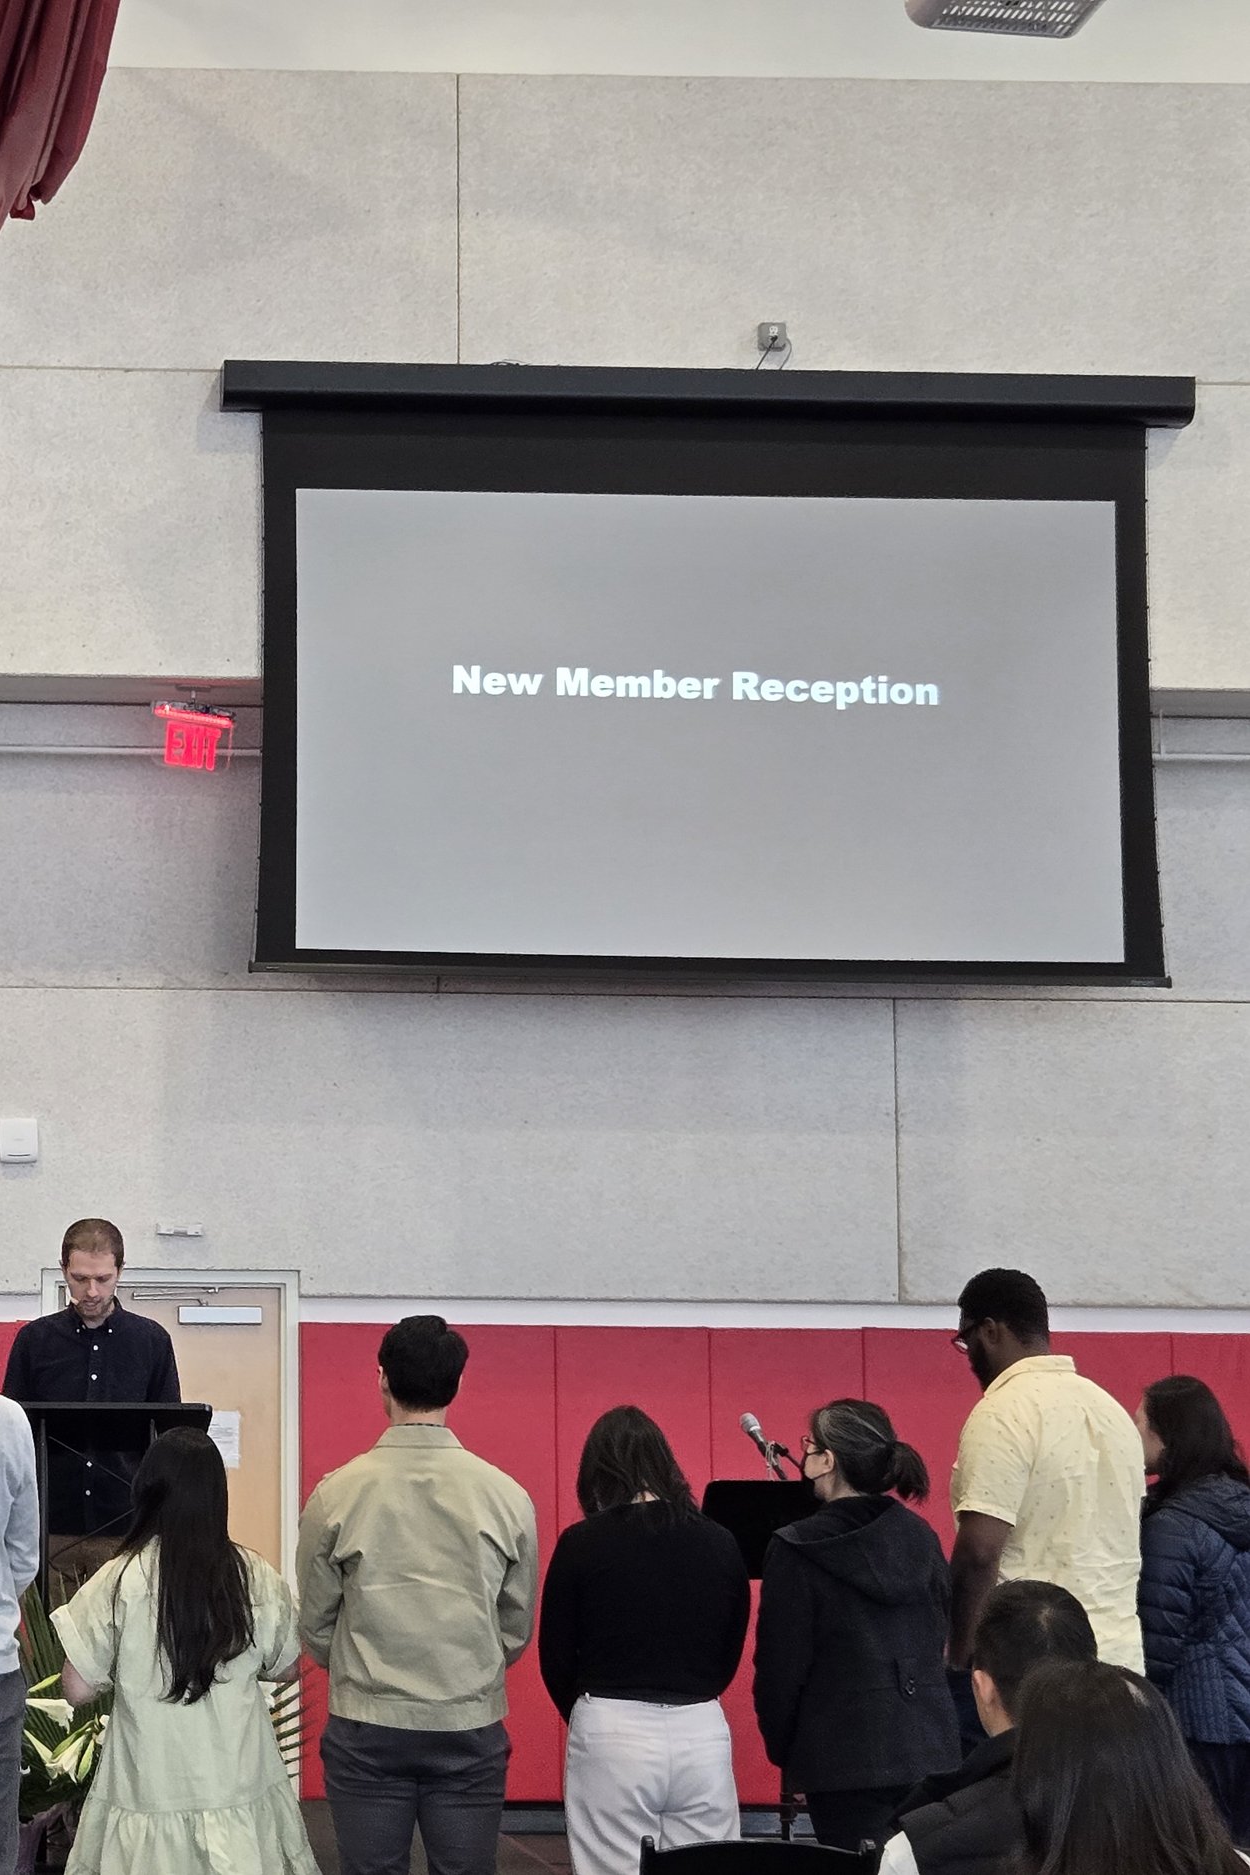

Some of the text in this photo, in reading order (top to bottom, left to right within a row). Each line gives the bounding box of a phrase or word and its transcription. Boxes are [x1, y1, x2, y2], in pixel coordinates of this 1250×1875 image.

[451, 664, 940, 710] New Member Reception
[164, 720, 222, 772] EXIT
